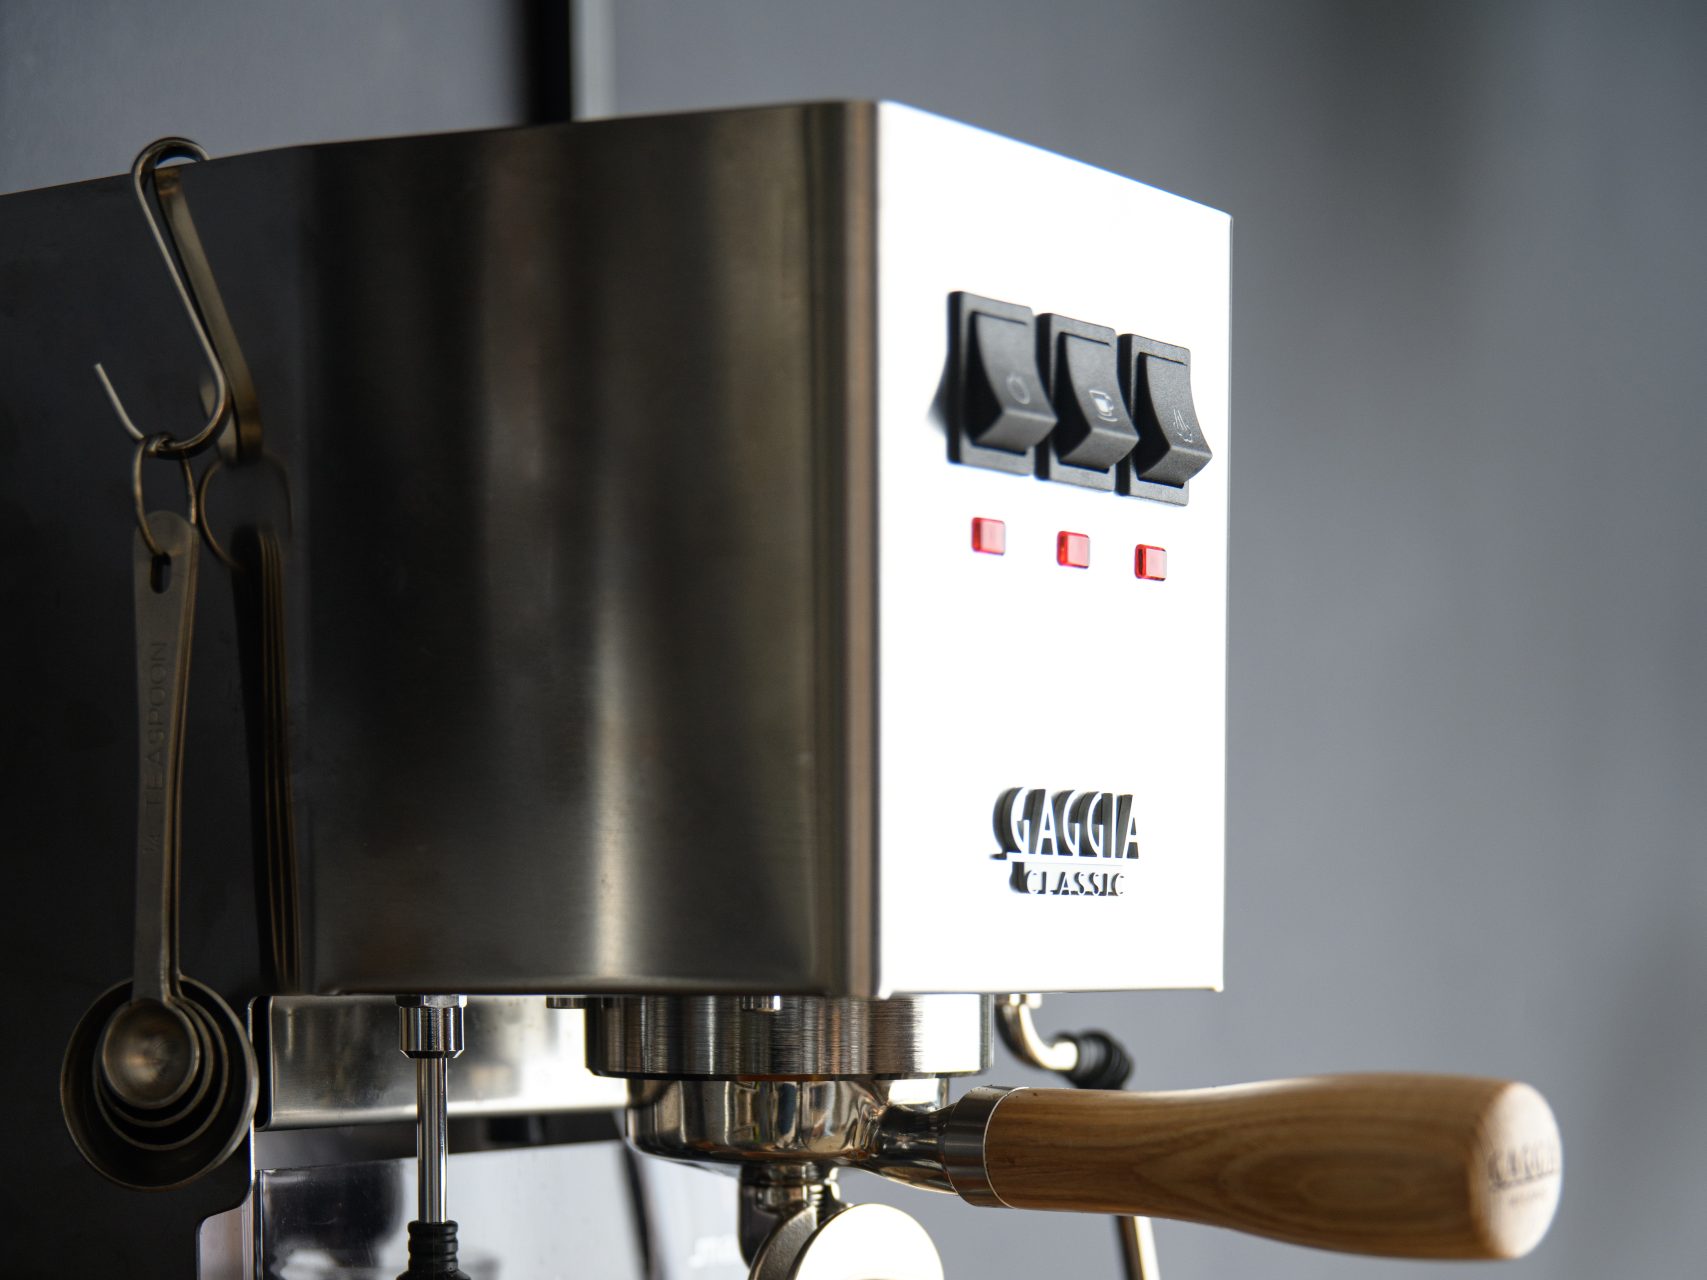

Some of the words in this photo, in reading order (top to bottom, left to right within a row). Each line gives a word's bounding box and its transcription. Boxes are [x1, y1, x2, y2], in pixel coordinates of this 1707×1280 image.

[145, 642, 168, 809] TEASPOON
[996, 786, 1141, 859] GAGGIA
[1020, 868, 1126, 897] CLASSIC
